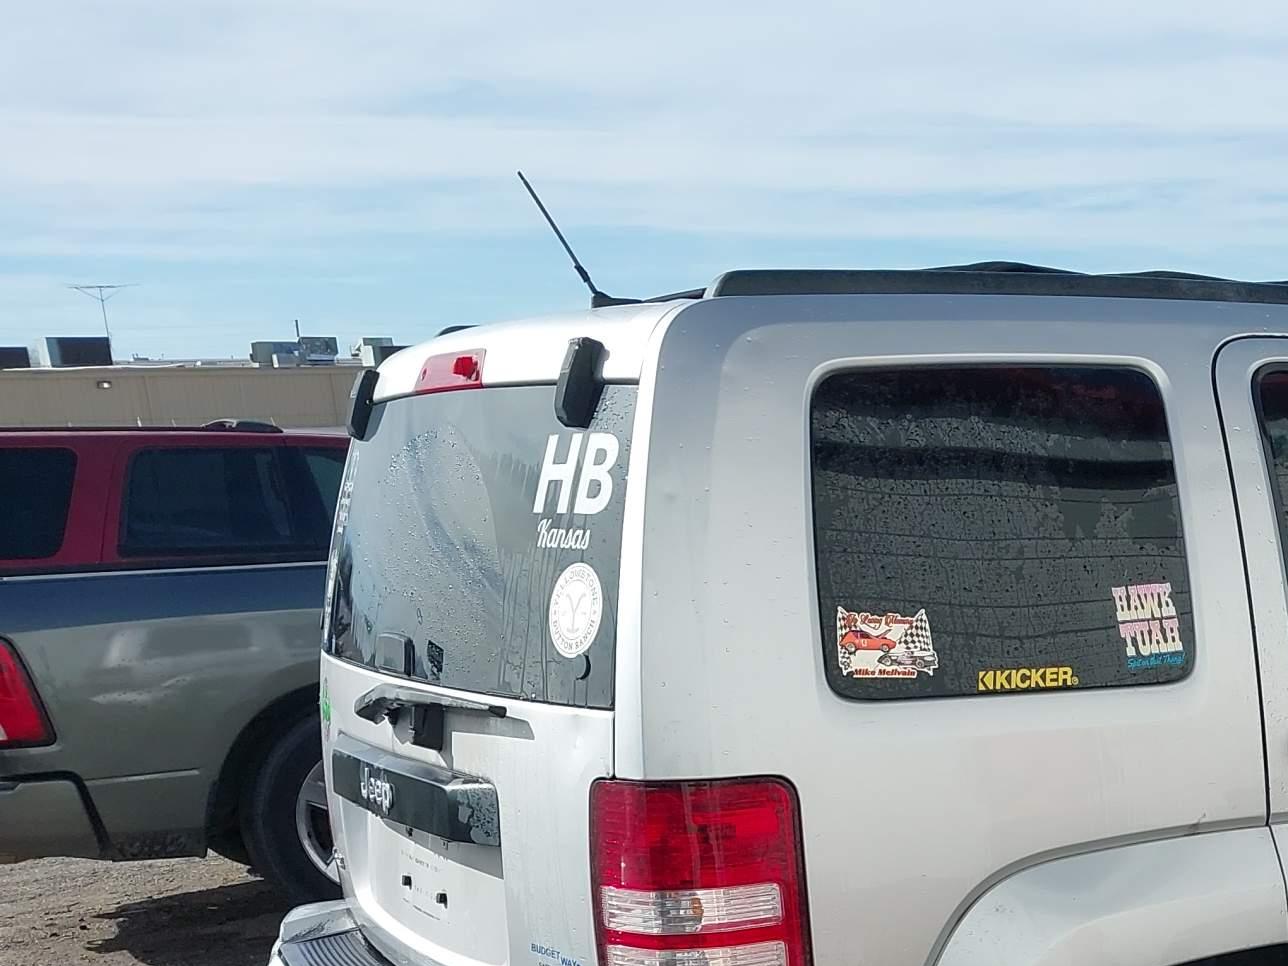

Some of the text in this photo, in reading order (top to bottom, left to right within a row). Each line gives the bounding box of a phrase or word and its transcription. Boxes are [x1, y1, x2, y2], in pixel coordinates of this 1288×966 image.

[533, 432, 619, 515] HB
[537, 518, 591, 550] Kansas
[1112, 582, 1177, 621] HAWK
[1119, 618, 1184, 657] TUAH
[361, 767, 393, 816] Jeep
[531, 943, 560, 959] BUDGET
